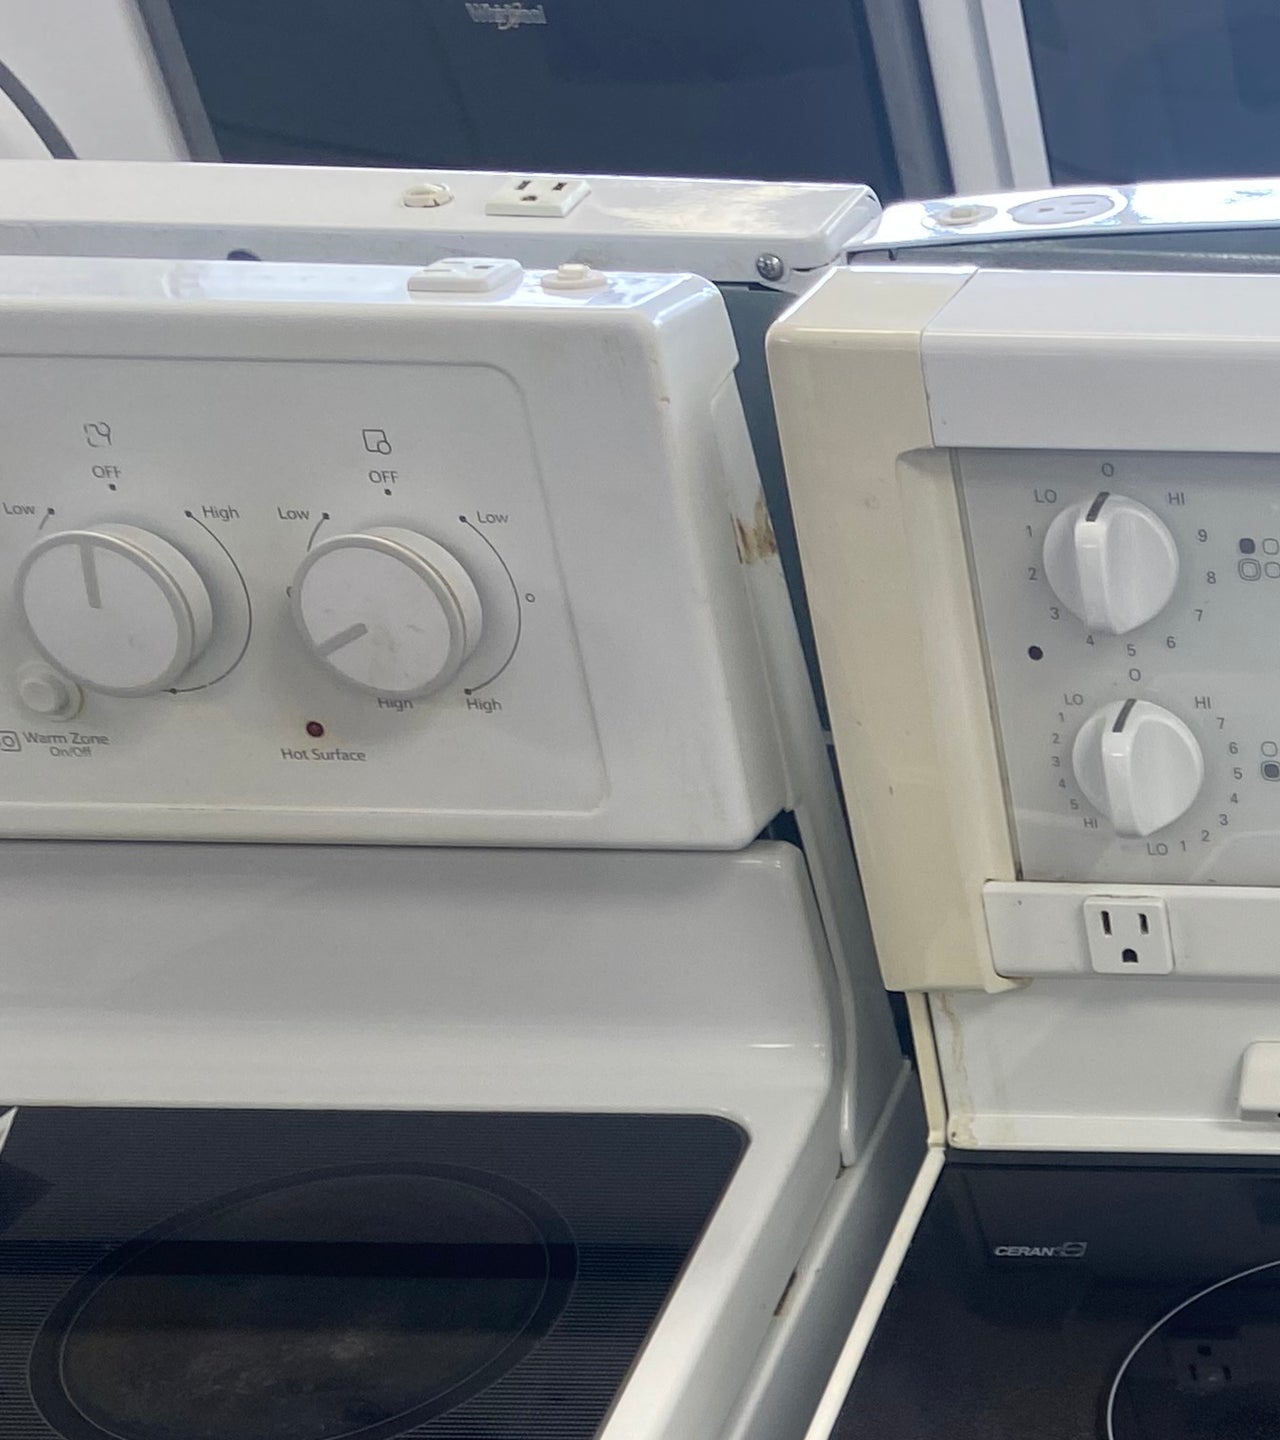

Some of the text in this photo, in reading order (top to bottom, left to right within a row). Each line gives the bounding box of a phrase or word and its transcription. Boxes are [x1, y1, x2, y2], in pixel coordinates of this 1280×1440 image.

[92, 465, 121, 478] OFF
[369, 470, 399, 484] OFF
[1034, 489, 1058, 504] LO
[1168, 492, 1186, 506] HI
[3, 503, 35, 515] Low
[202, 505, 240, 520] High
[277, 506, 310, 520] Low
[477, 510, 509, 524] Low
[1197, 529, 1208, 543] 9
[1028, 567, 1038, 581] 2
[1206, 571, 1217, 585] 8
[1050, 607, 1060, 621] 3
[1194, 609, 1204, 623] 7
[1086, 634, 1095, 648] 4
[1166, 635, 1176, 650] 6
[1127, 643, 1136, 657] 5
[466, 698, 502, 713] High
[1064, 693, 1084, 707] LO
[1194, 697, 1211, 710] HI
[1216, 717, 1225, 729] 7
[23, 731, 110, 745] Warm Zone
[1052, 733, 1060, 744] 2
[281, 748, 367, 762] Hot Surface
[1229, 742, 1238, 755] 6
[1052, 756, 1060, 767] 3
[1233, 767, 1243, 780] 5
[1058, 778, 1066, 788] 4
[1070, 799, 1079, 810] 5
[1230, 793, 1239, 804] 4
[1084, 818, 1098, 829] HI
[1219, 814, 1229, 826] 3
[1201, 830, 1210, 842] 2
[1147, 843, 1169, 856] LO
[994, 1246, 1054, 1256] CERAN
